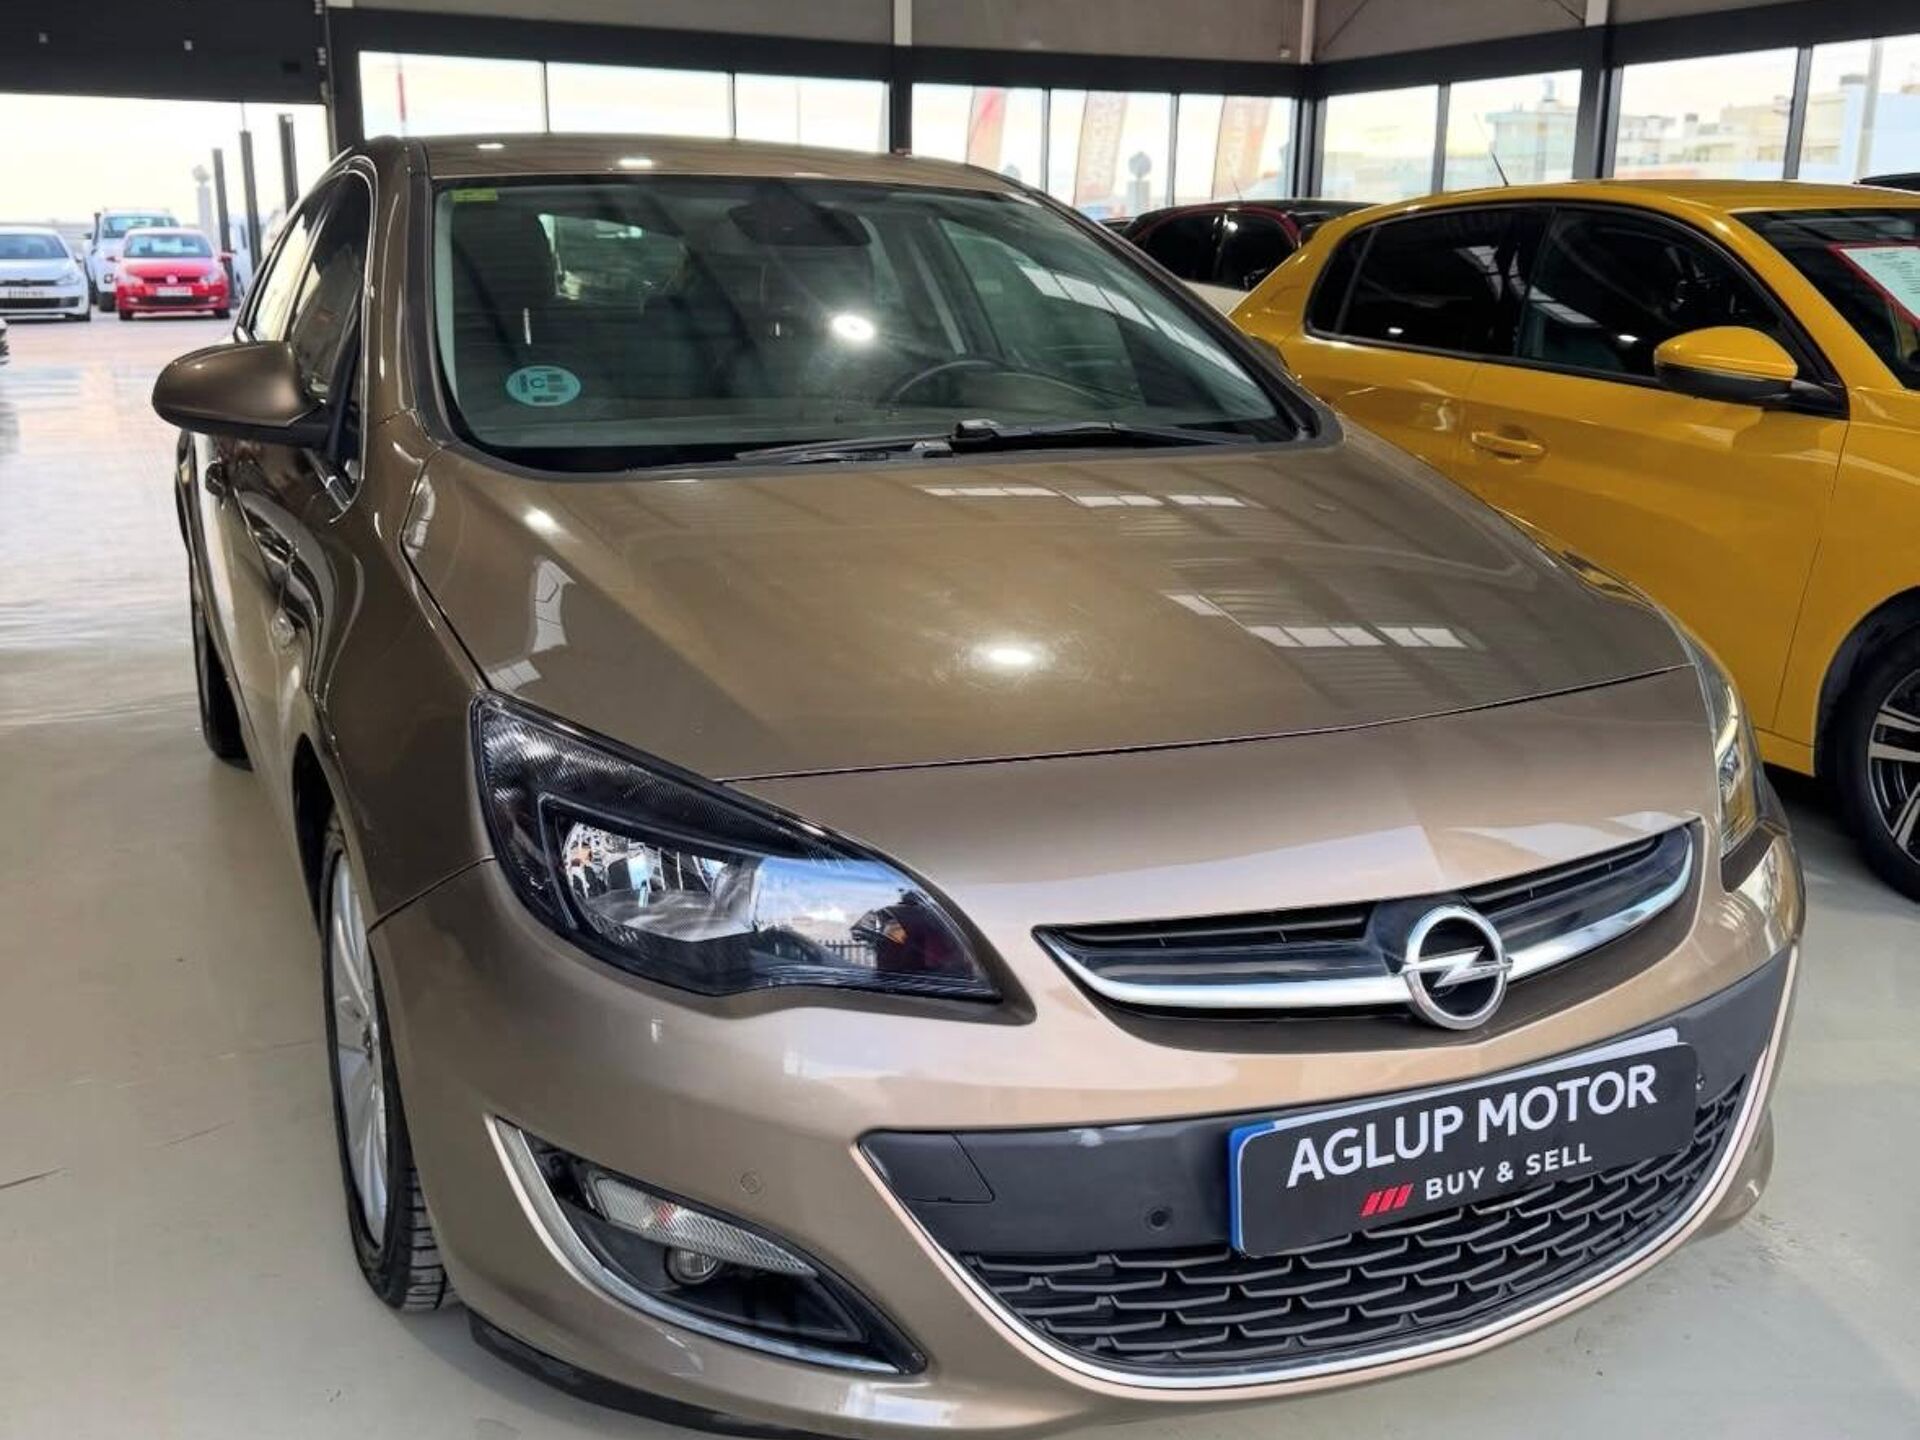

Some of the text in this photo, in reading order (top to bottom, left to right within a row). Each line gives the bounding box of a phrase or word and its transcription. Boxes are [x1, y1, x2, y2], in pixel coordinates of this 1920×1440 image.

[1286, 1064, 1658, 1188] AGLUP MOTOR
[1425, 1142, 1593, 1201] BUY & SELL
